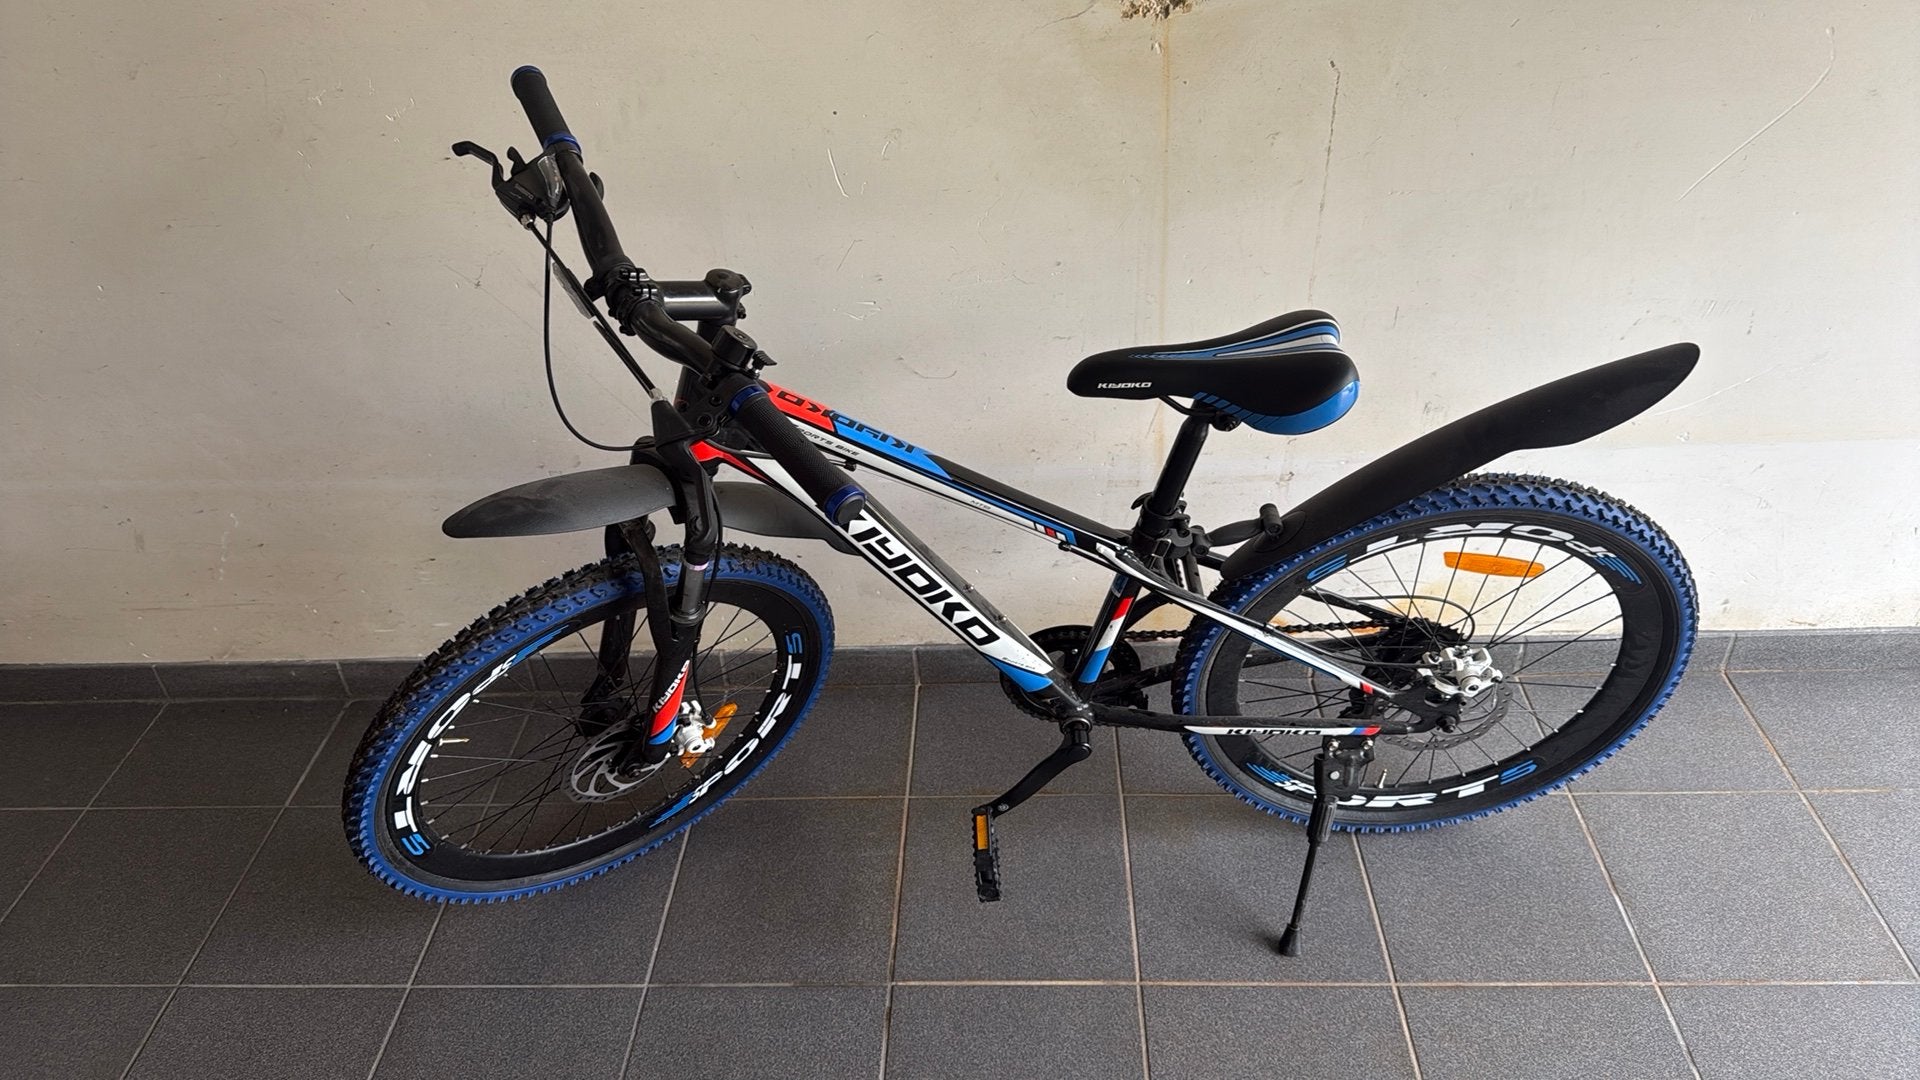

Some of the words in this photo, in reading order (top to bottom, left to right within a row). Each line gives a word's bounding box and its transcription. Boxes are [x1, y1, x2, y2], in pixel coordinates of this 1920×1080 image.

[1097, 381, 1153, 390] KIYOKO
[777, 390, 916, 454] KIYOKO
[840, 513, 1000, 647] IYOKO
